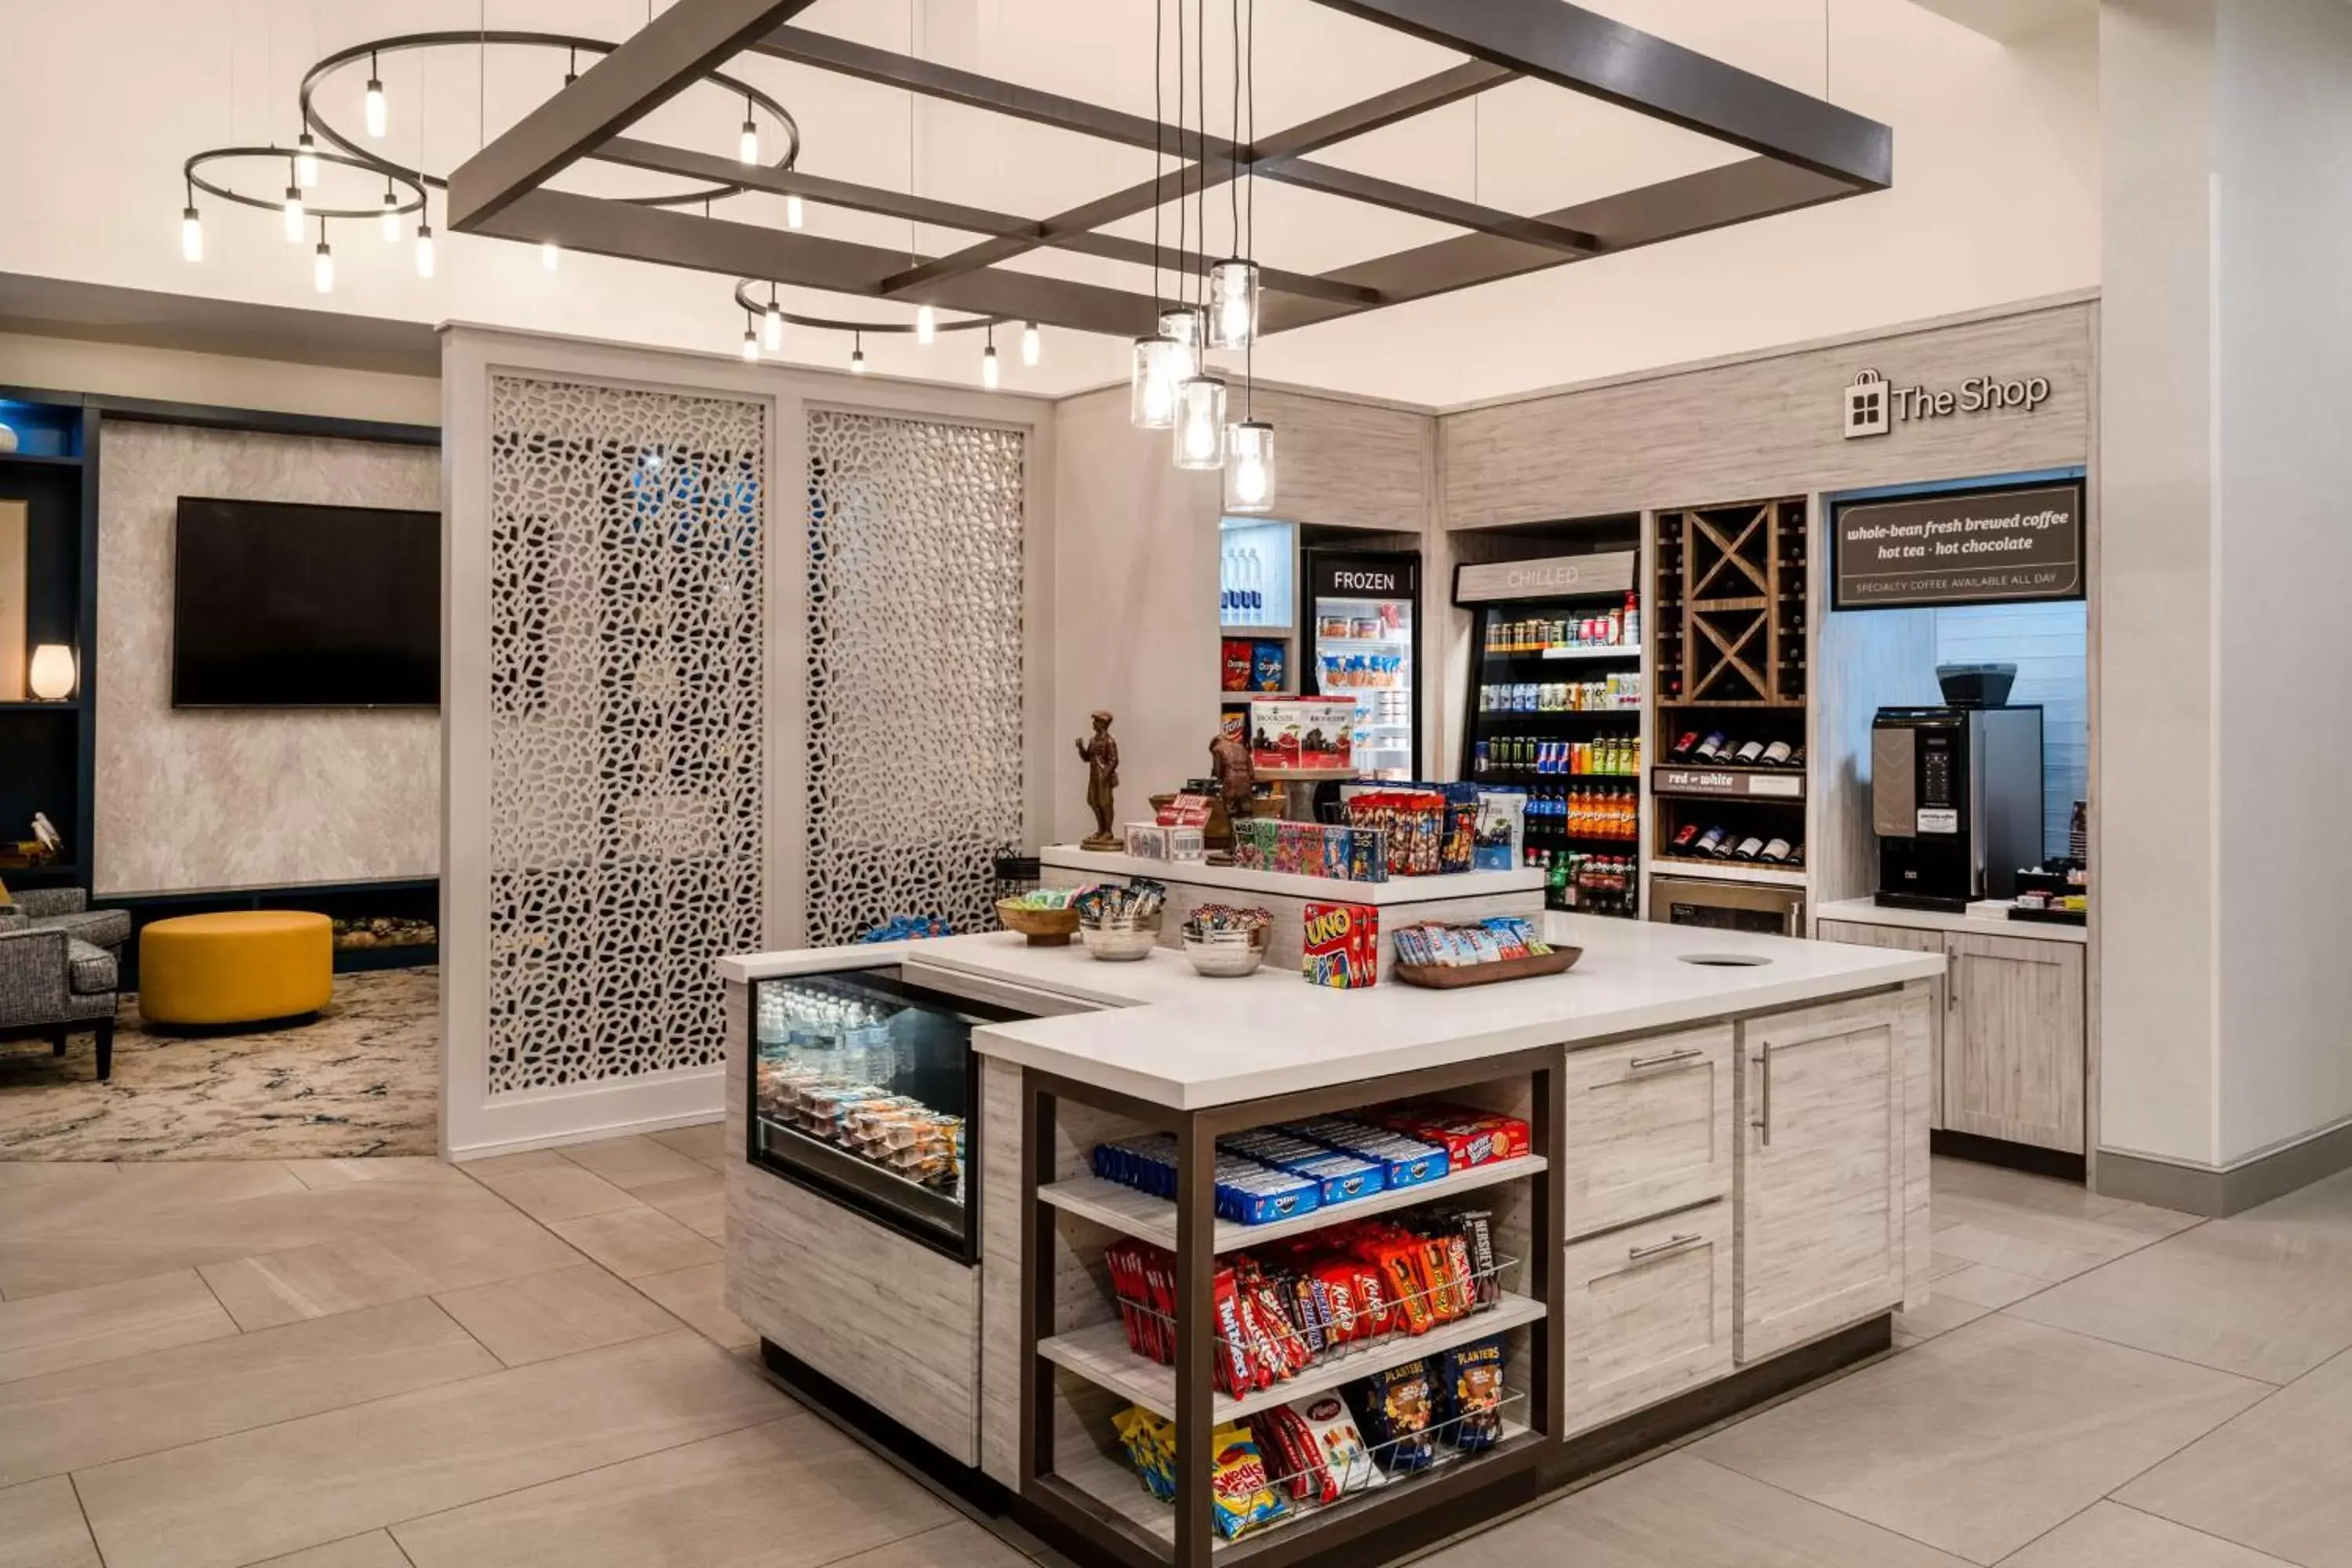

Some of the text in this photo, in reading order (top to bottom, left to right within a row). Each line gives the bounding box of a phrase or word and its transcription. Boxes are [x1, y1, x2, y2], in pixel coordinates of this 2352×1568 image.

[1893, 375, 2050, 422] The Shop
[1847, 510, 2069, 540] whole-bean fresh brewed coffee
[1877, 536, 2033, 559] hot tea hot chocolate
[1334, 571, 1395, 590] FROZEN
[1507, 566, 1580, 588] CHILLED
[1856, 572, 2058, 594] SPECIALTY COFFEE AVAILABLE ALL DAY
[1668, 772, 1688, 784] red
[1700, 772, 1733, 786] white
[1305, 908, 1351, 946] UNO
[1458, 1346, 1500, 1366] PLANTERS
[1211, 1463, 1264, 1498] Swedis
